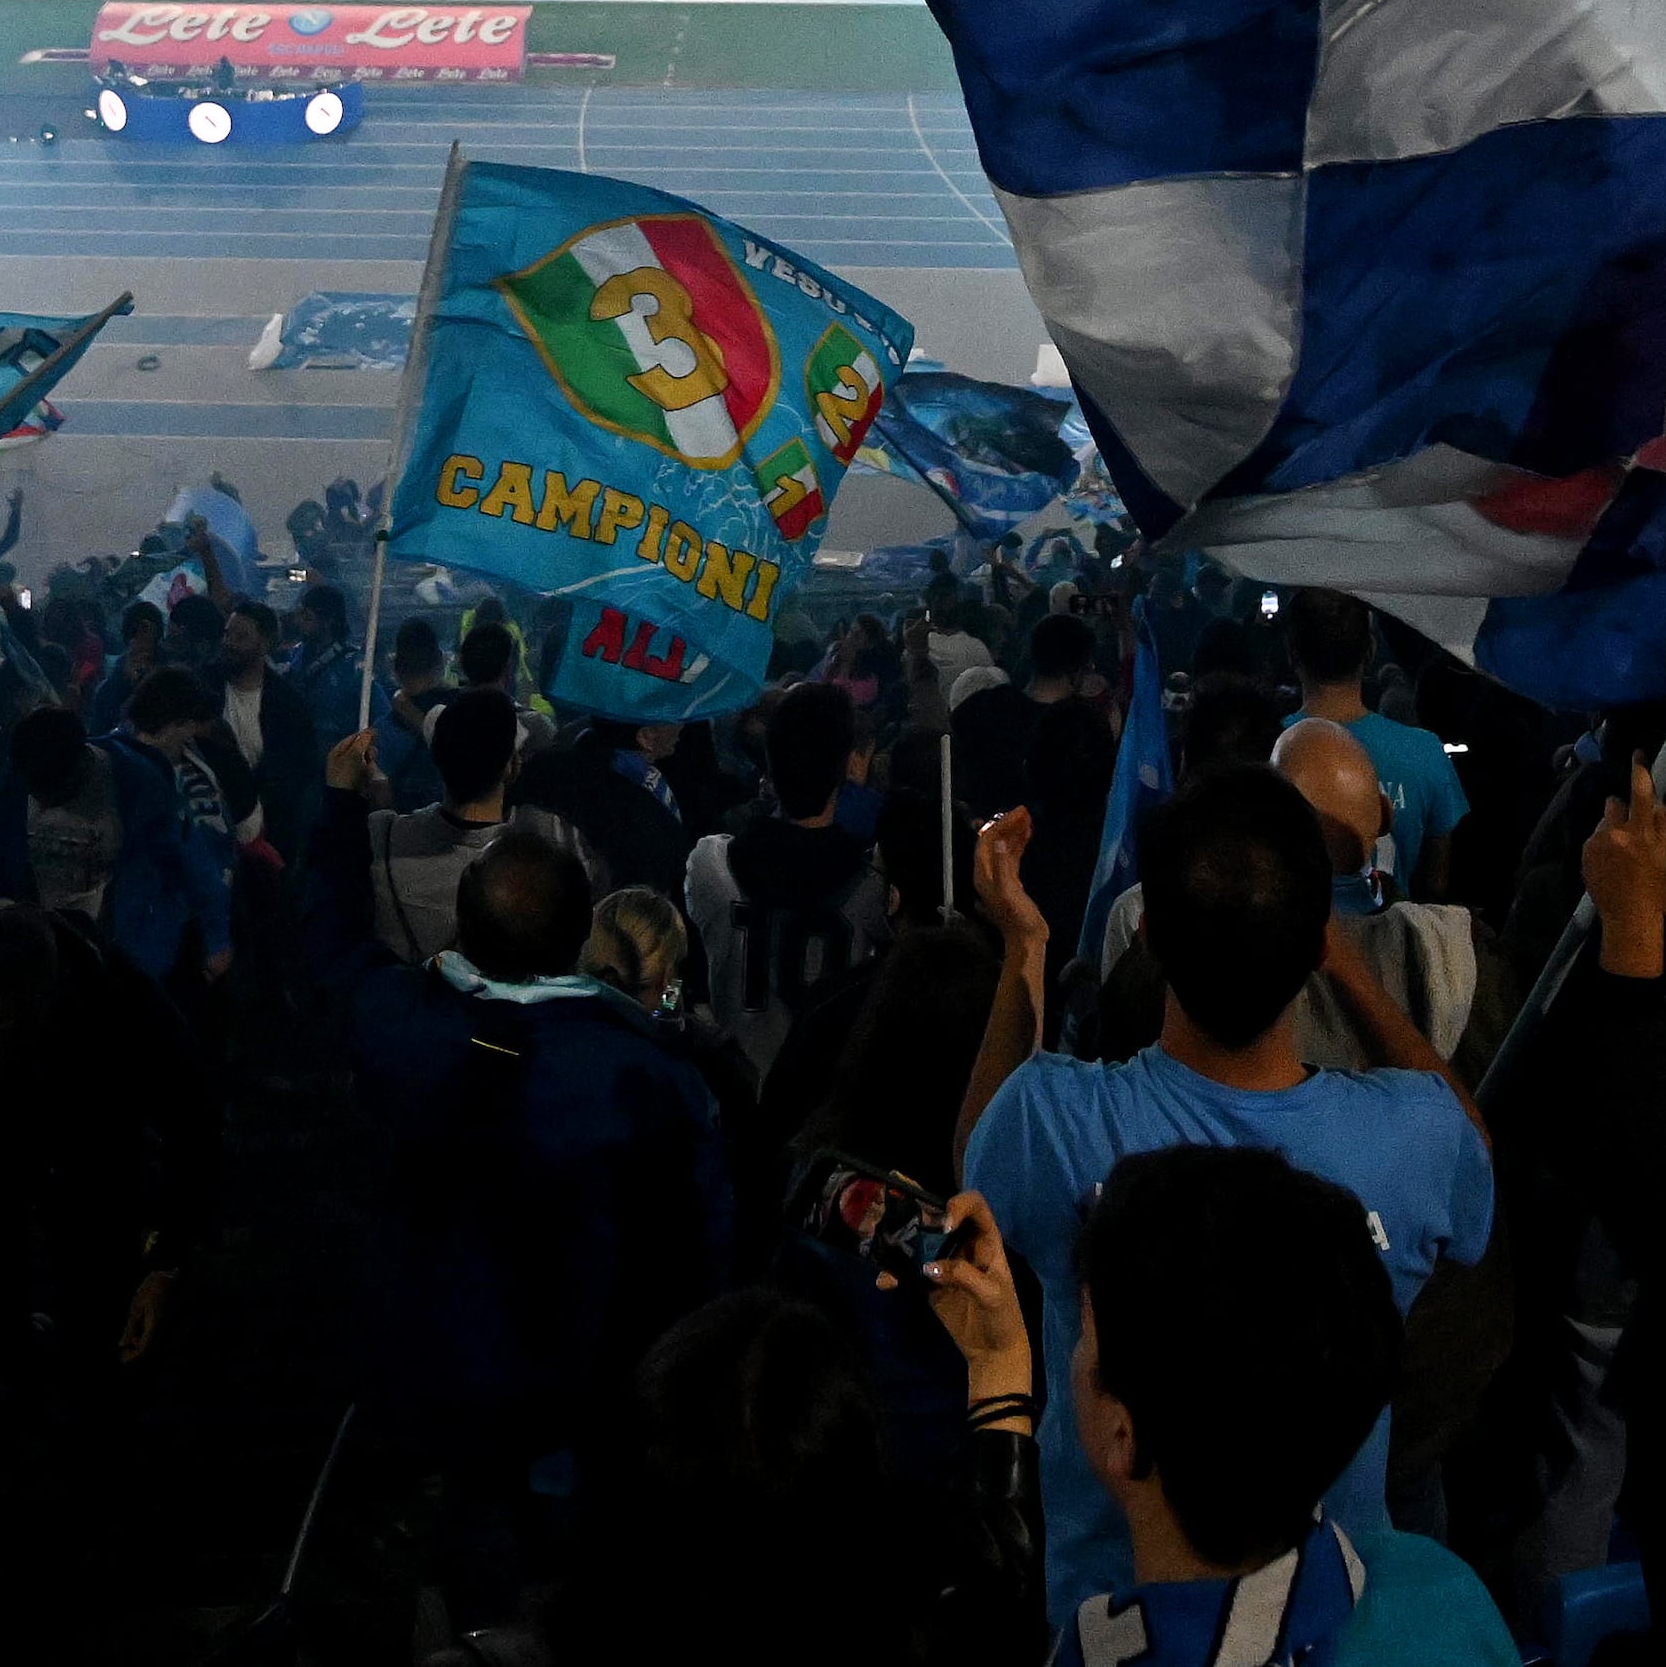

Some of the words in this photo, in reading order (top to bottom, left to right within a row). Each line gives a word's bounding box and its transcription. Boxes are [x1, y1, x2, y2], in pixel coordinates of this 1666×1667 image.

[98, 4, 273, 46] Lete
[345, 7, 519, 49] Lete
[590, 266, 729, 411] 3
[816, 365, 870, 448] 2
[436, 454, 781, 622] CAMPIONI
